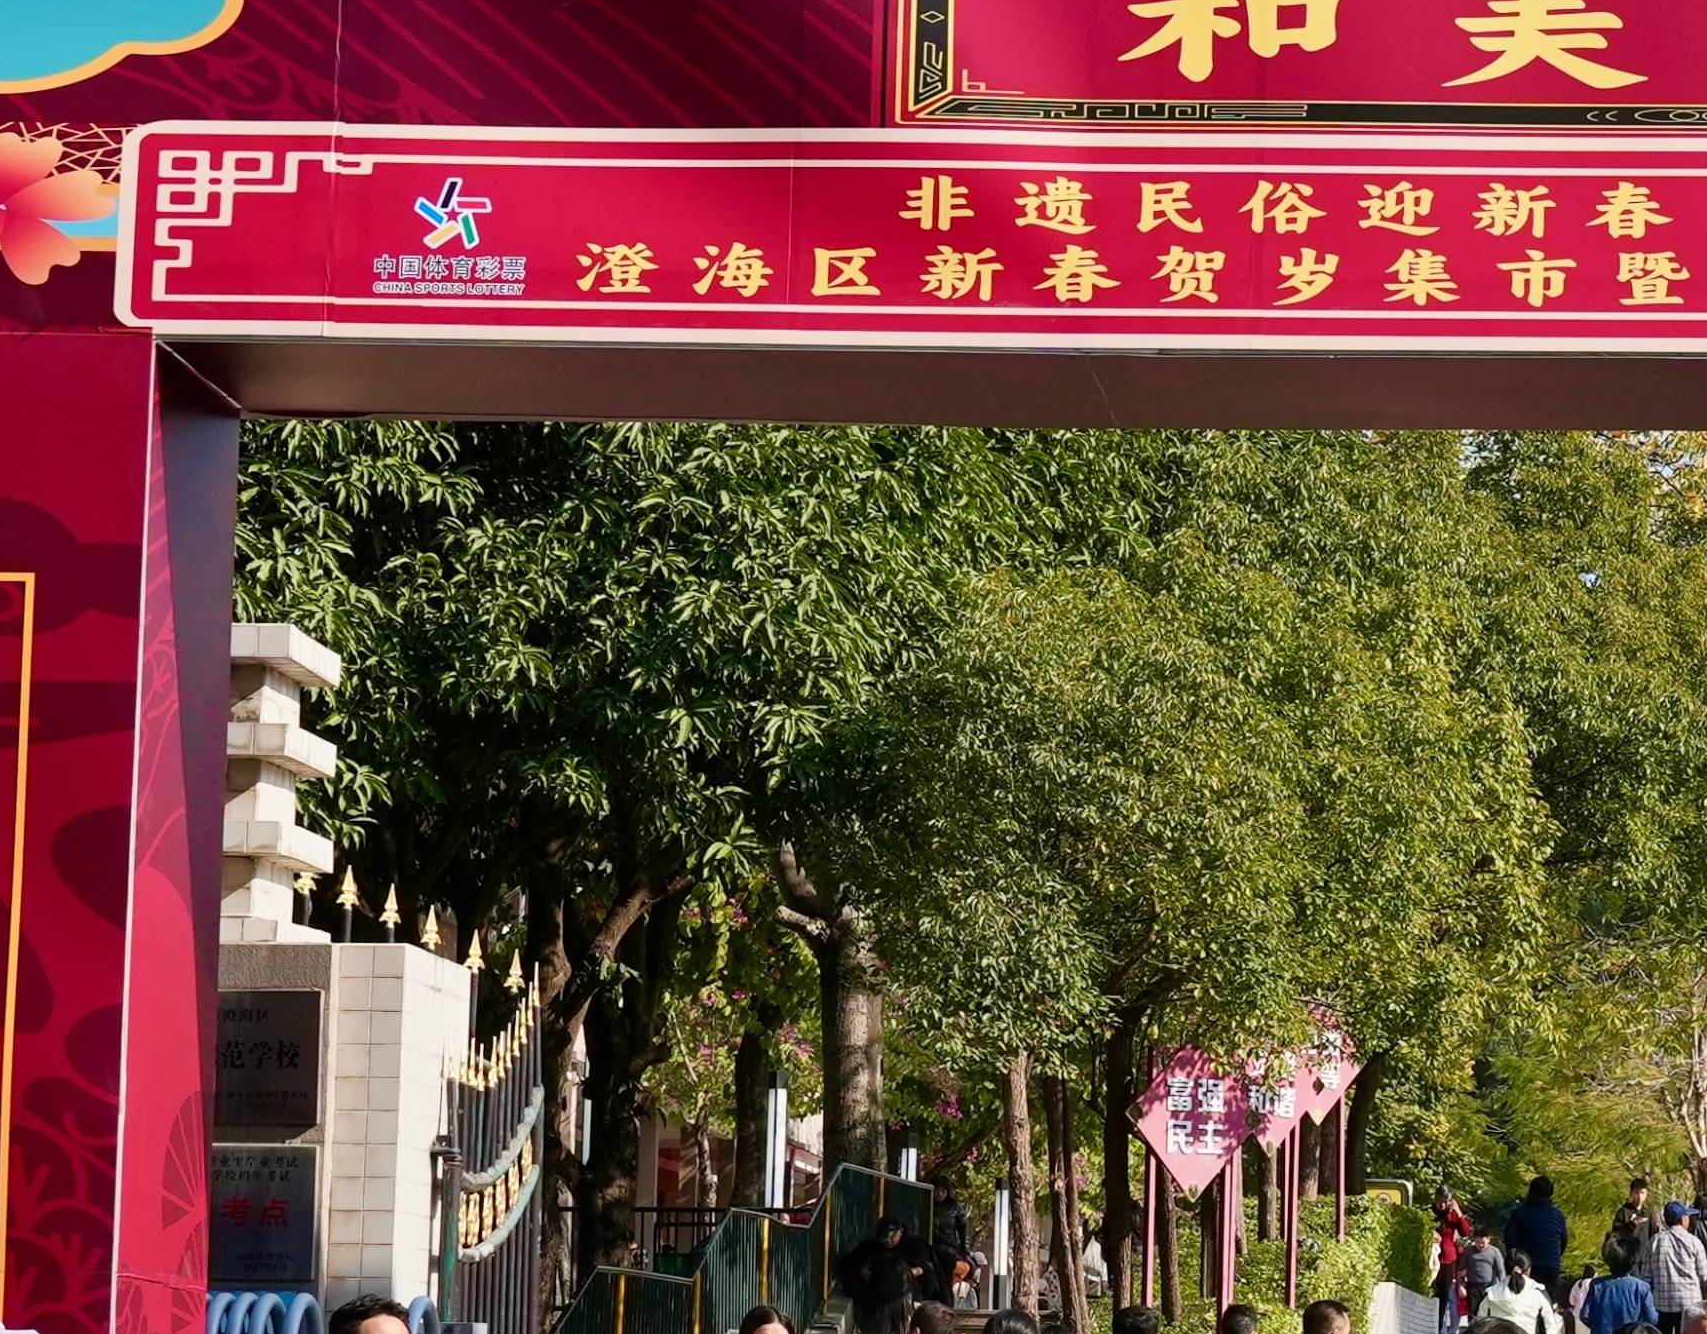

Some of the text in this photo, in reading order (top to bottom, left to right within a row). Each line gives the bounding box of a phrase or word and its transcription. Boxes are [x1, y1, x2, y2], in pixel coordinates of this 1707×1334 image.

[901, 176, 1667, 237] 非遗民俗迎新春
[373, 253, 527, 280] 中国体育彩票
[373, 281, 526, 296] CHINA SPORTS LOTTERY
[217, 1008, 269, 1023] 澄海区
[1167, 1077, 1226, 1114] 富强
[1248, 1084, 1297, 1118] 和谐
[1166, 1119, 1226, 1155] 民主
[221, 1195, 289, 1227] 考点
